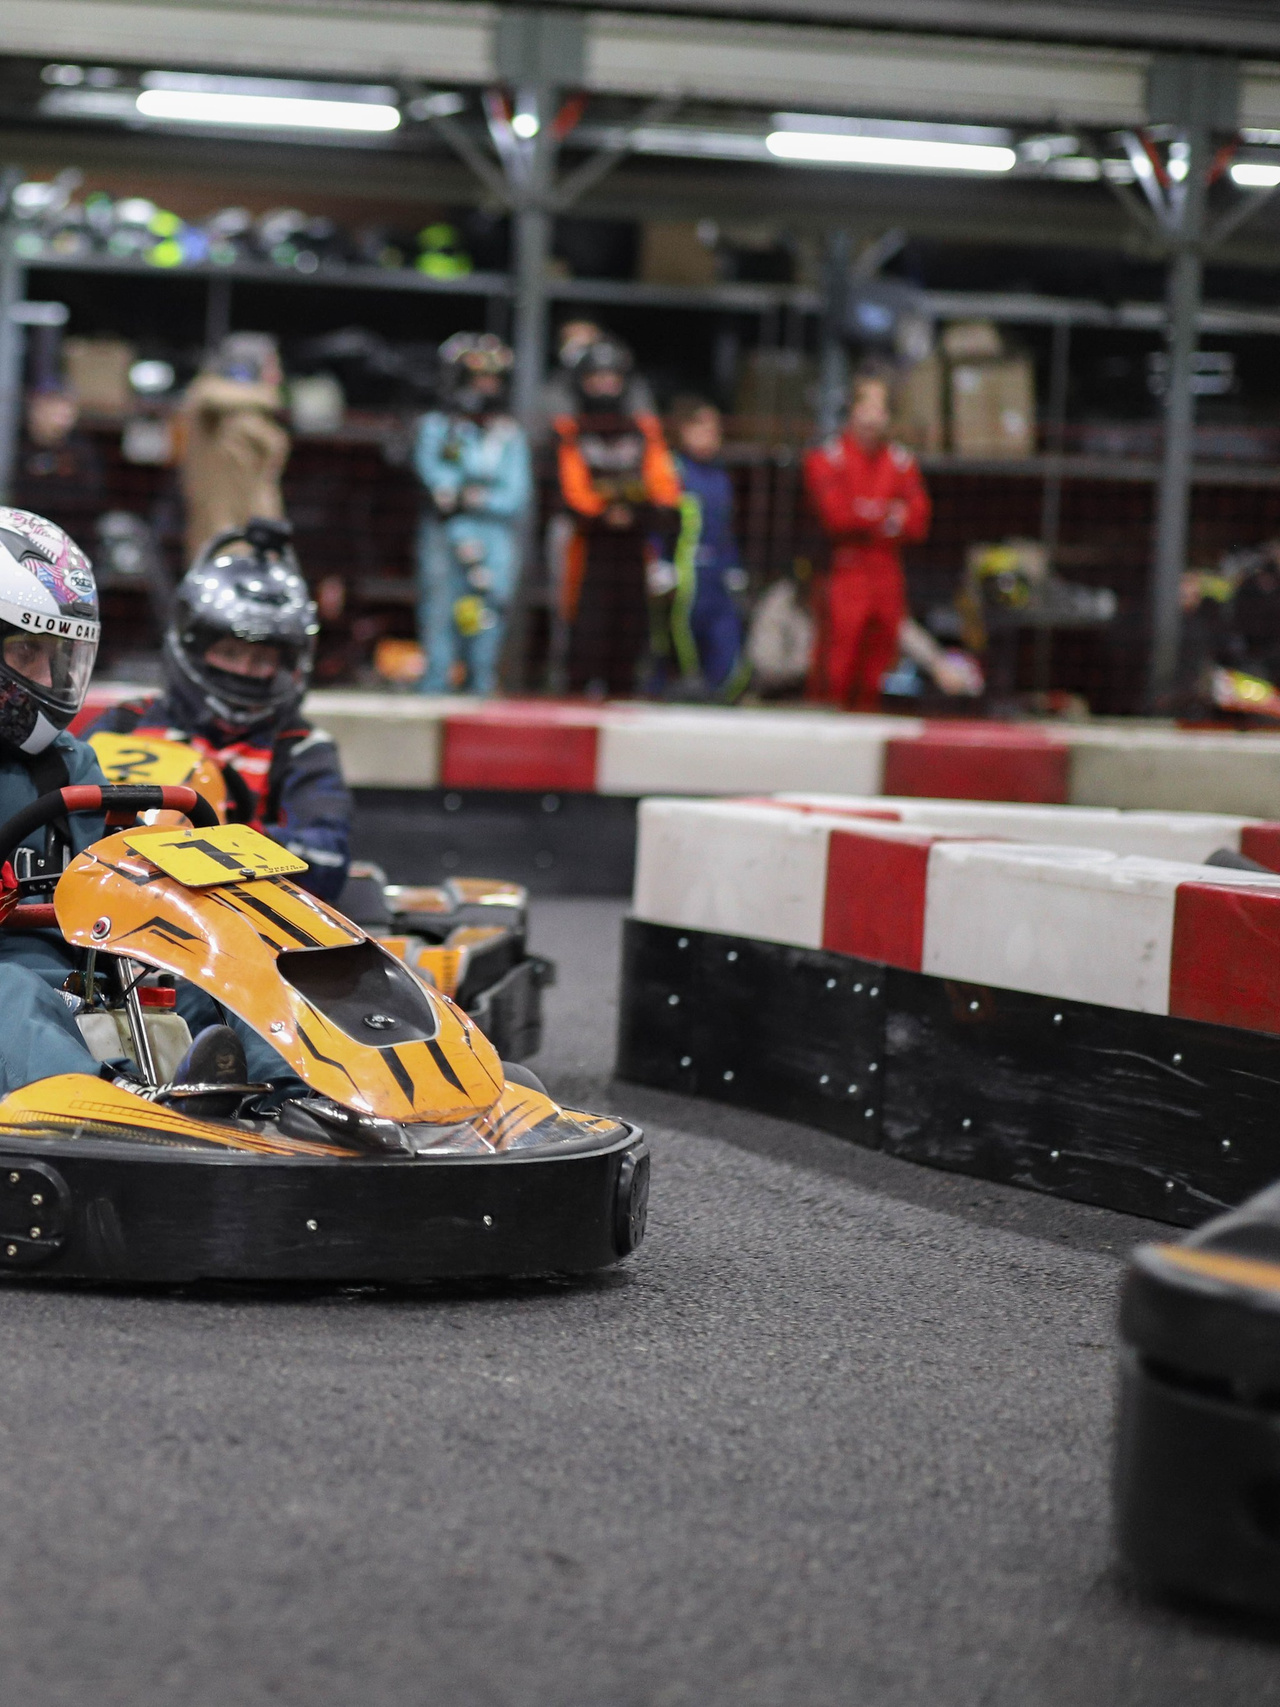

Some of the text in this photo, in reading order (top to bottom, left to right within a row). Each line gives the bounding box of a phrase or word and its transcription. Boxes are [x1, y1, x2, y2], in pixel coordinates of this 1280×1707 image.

[21, 612, 99, 640] SLOW CAR
[107, 749, 158, 776] 2
[173, 839, 246, 870] 1
